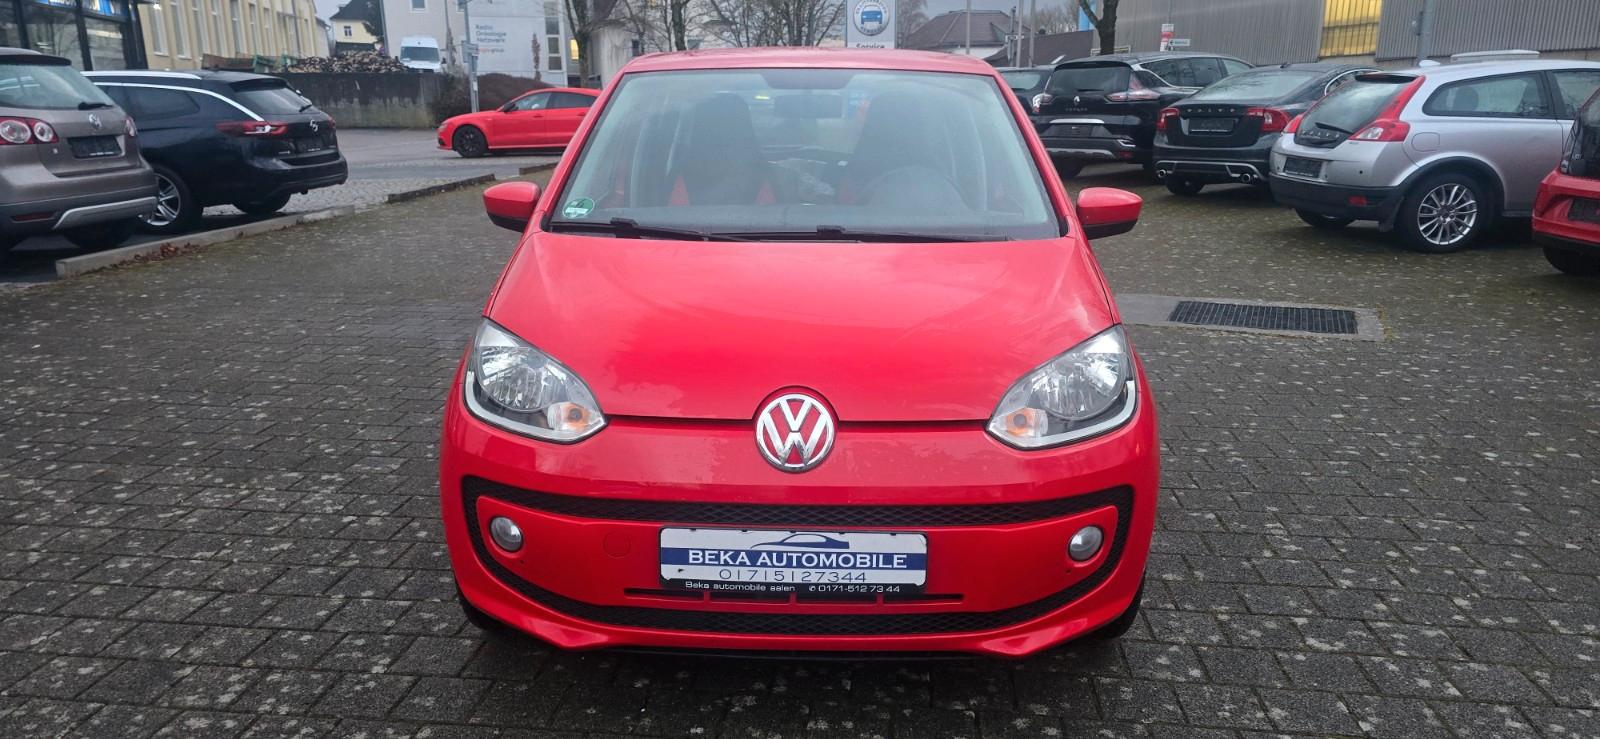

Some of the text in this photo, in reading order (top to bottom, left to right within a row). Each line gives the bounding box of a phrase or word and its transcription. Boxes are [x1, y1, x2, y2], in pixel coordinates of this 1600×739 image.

[758, 394, 833, 468] VW
[688, 549, 908, 569] BEKA AUTOMOBILE
[719, 569, 867, 583] 01715127344
[685, 581, 710, 589] Beka
[713, 582, 767, 592] automobile
[886, 585, 900, 593] 44
